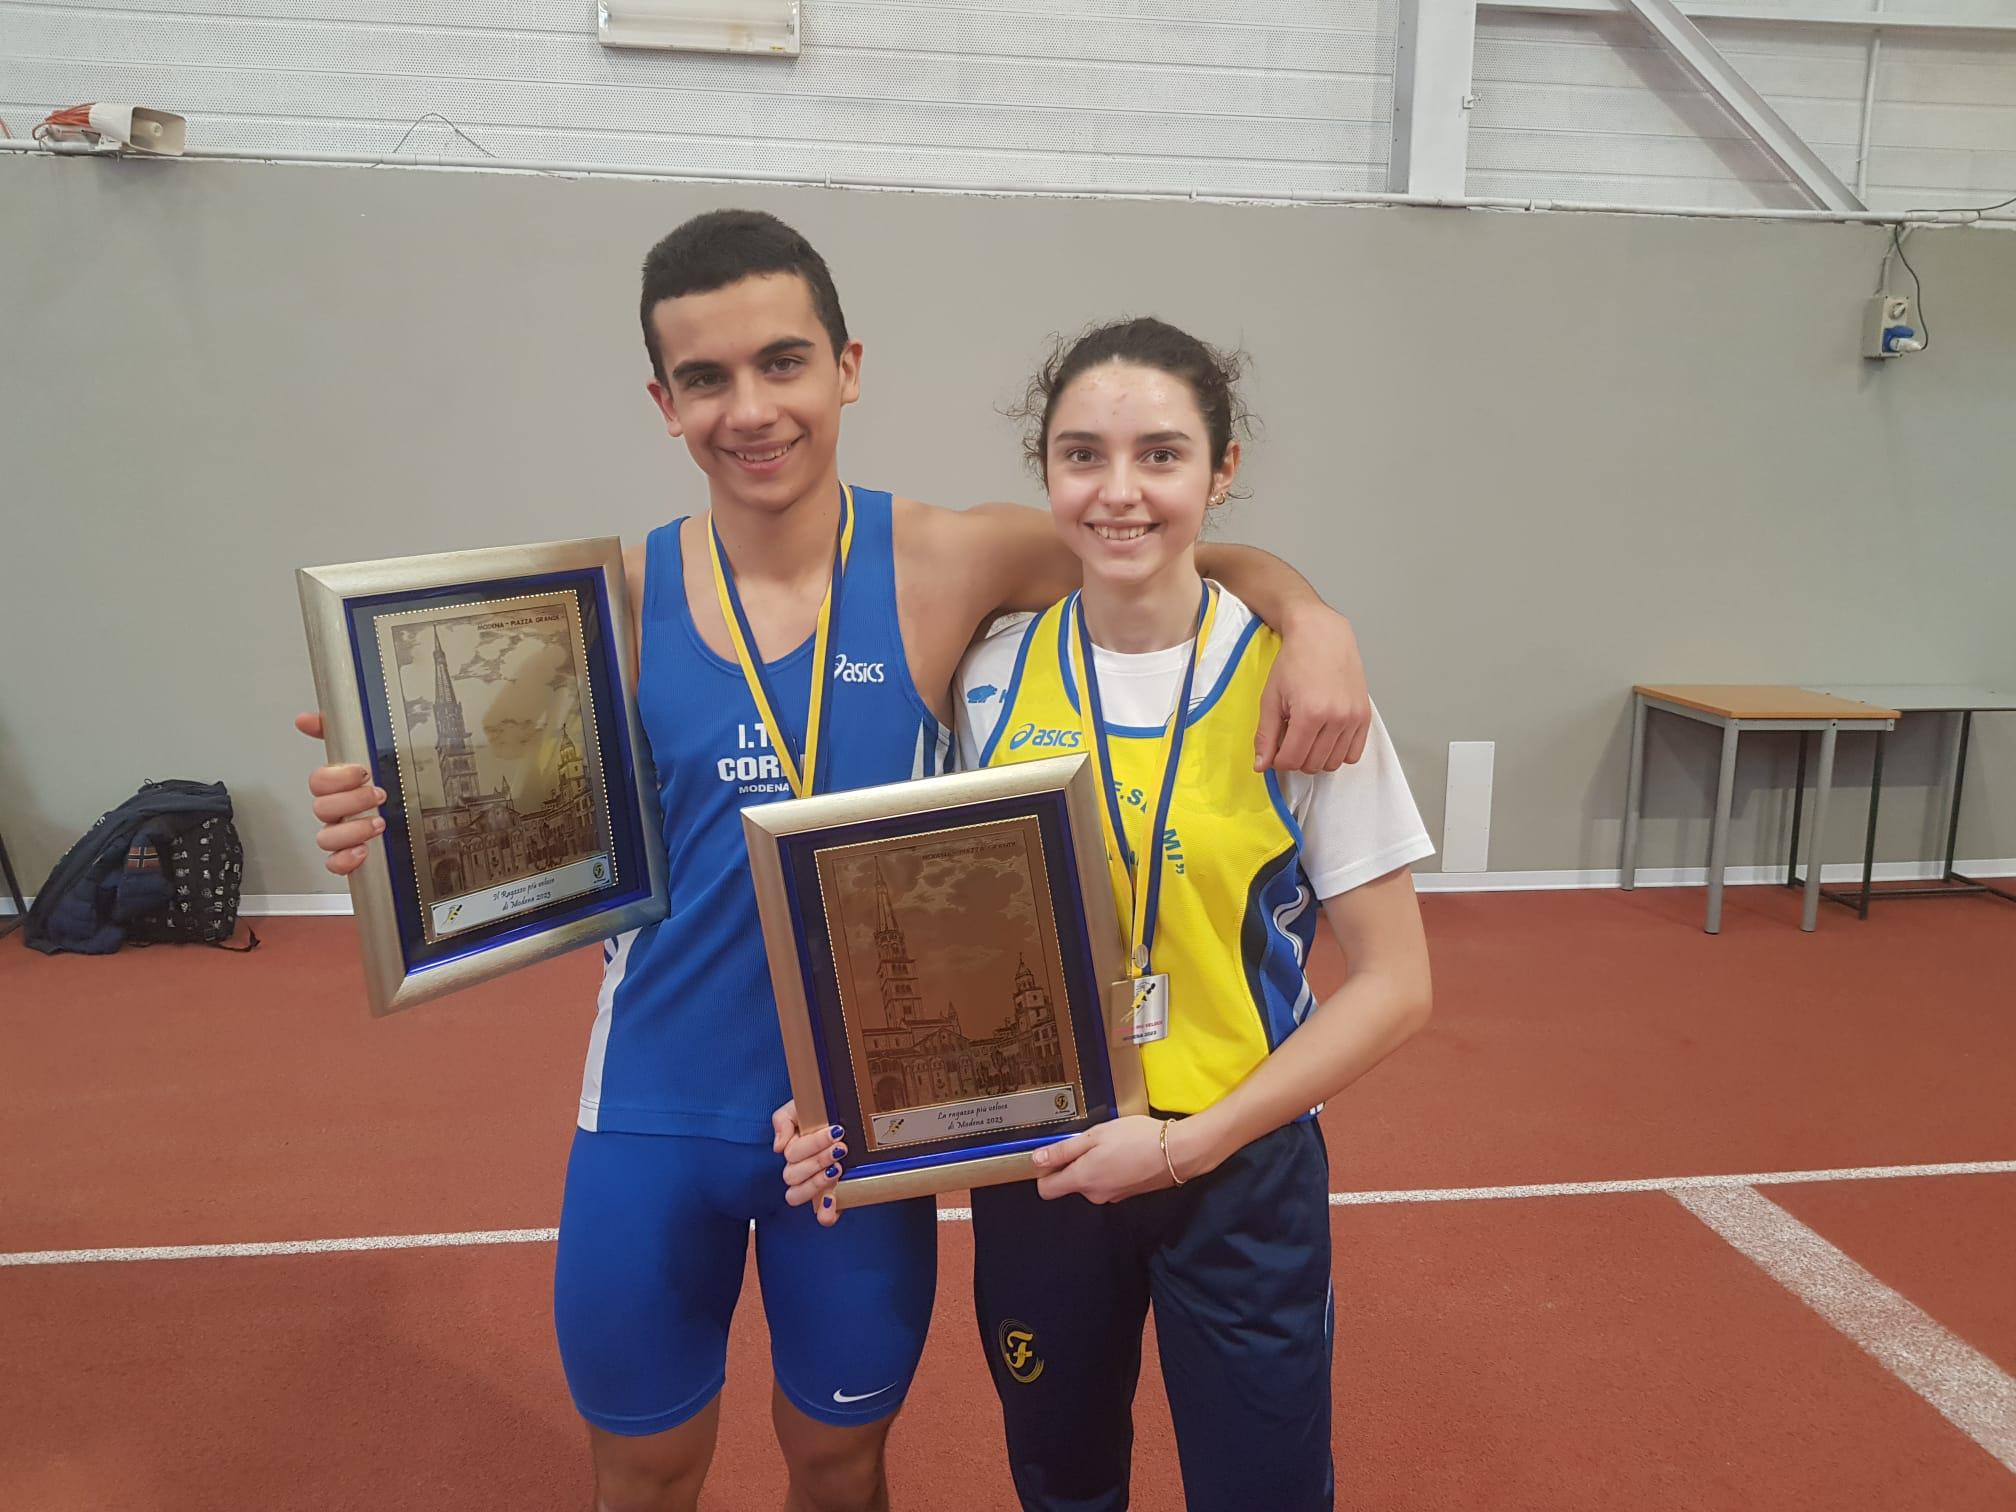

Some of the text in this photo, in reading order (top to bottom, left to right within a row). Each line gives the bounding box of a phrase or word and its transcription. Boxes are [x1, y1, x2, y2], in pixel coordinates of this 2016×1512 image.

[738, 782, 790, 794] MODENA
[937, 1111, 947, 1120] La
[948, 1109, 974, 1121] ragazza
[988, 1101, 1008, 1112] veloce
[947, 1117, 1003, 1130] di Modena 2023
